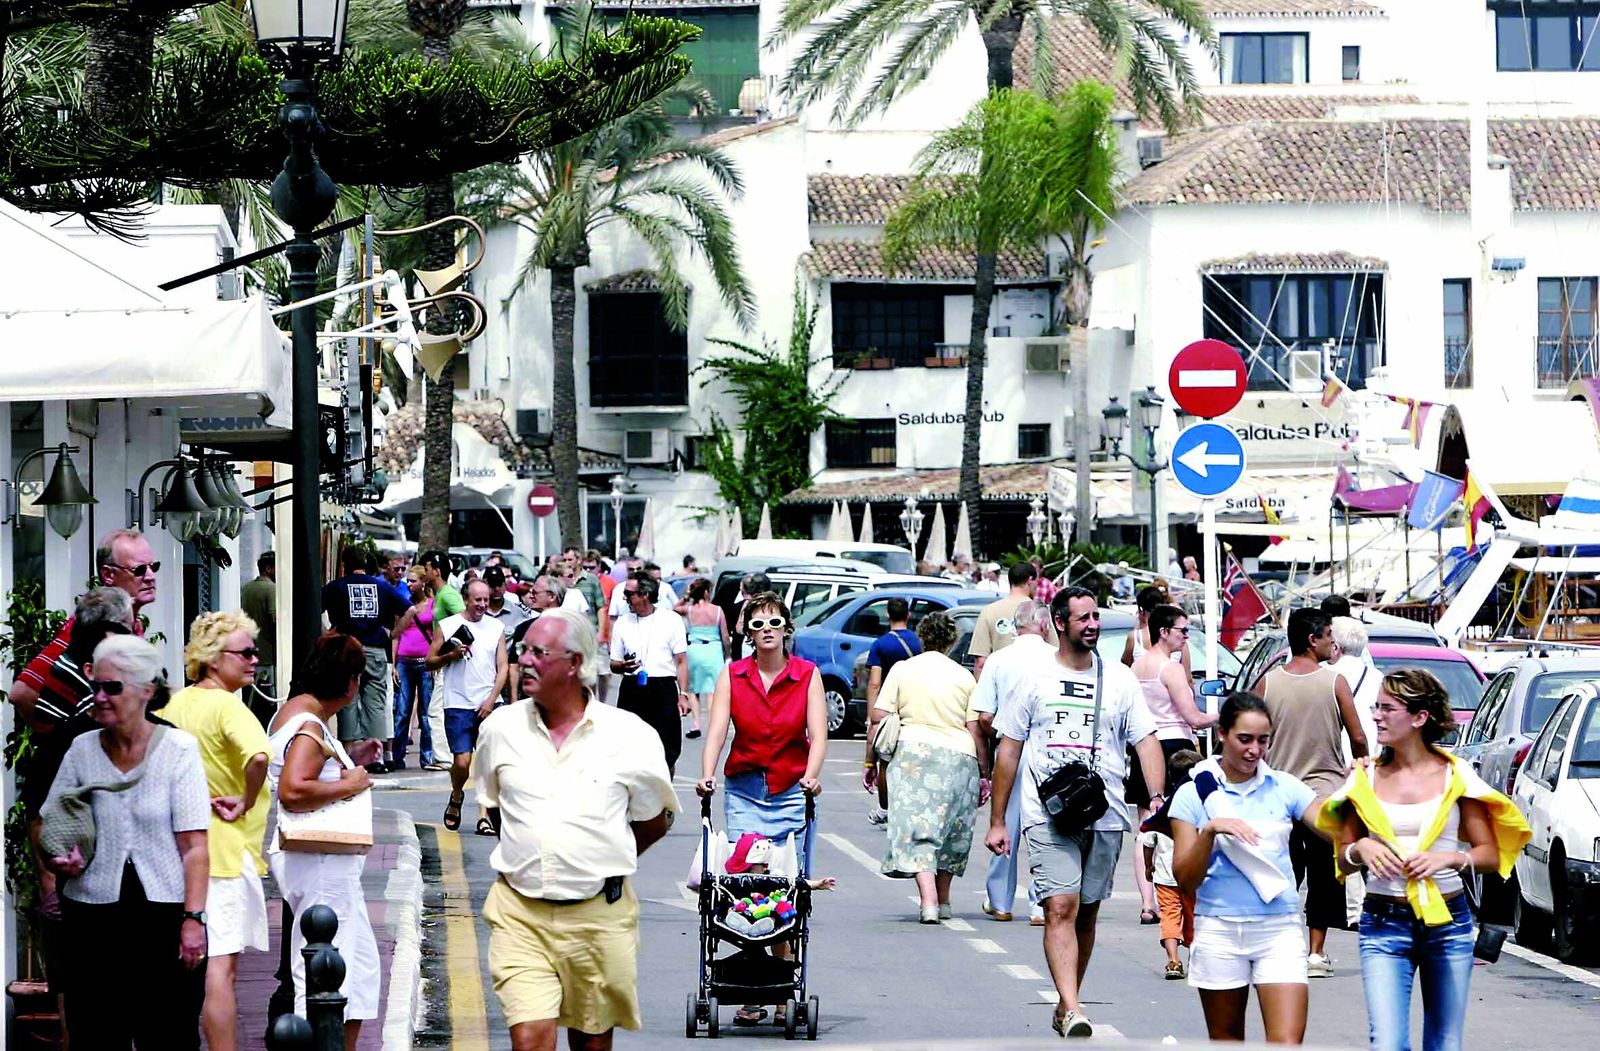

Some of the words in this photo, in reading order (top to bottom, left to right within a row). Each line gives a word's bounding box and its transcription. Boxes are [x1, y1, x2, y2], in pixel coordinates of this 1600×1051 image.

[898, 412, 966, 425] Salduba
[463, 466, 496, 478] Helados
[1225, 497, 1286, 509] Saldba
[1059, 680, 1094, 699] E
